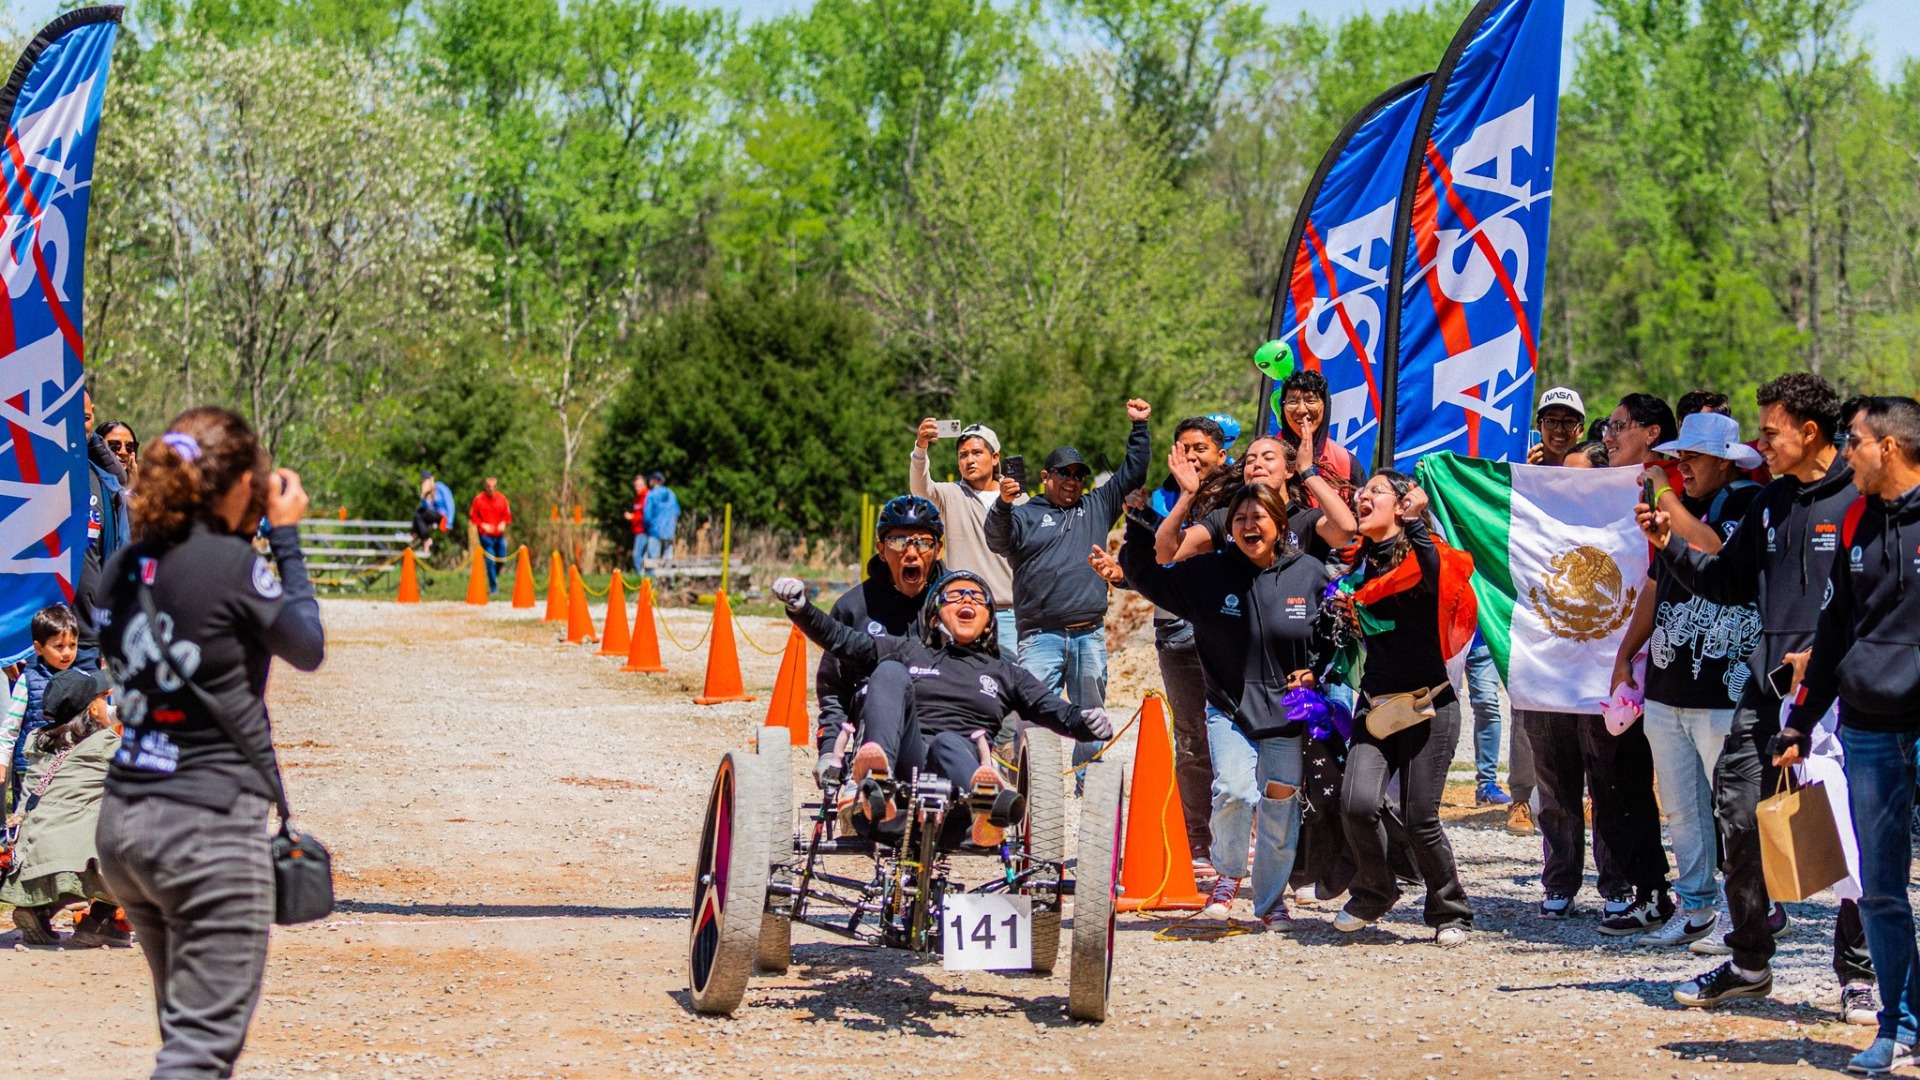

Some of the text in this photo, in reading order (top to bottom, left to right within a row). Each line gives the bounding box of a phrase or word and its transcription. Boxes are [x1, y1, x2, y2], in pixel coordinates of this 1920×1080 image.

[0, 71, 97, 586] NASA
[1304, 197, 1396, 452] ASA
[1432, 94, 1534, 463] ASA
[1545, 392, 1573, 403] NASA
[1815, 524, 1837, 533] NASA
[950, 914, 1018, 950] 141
